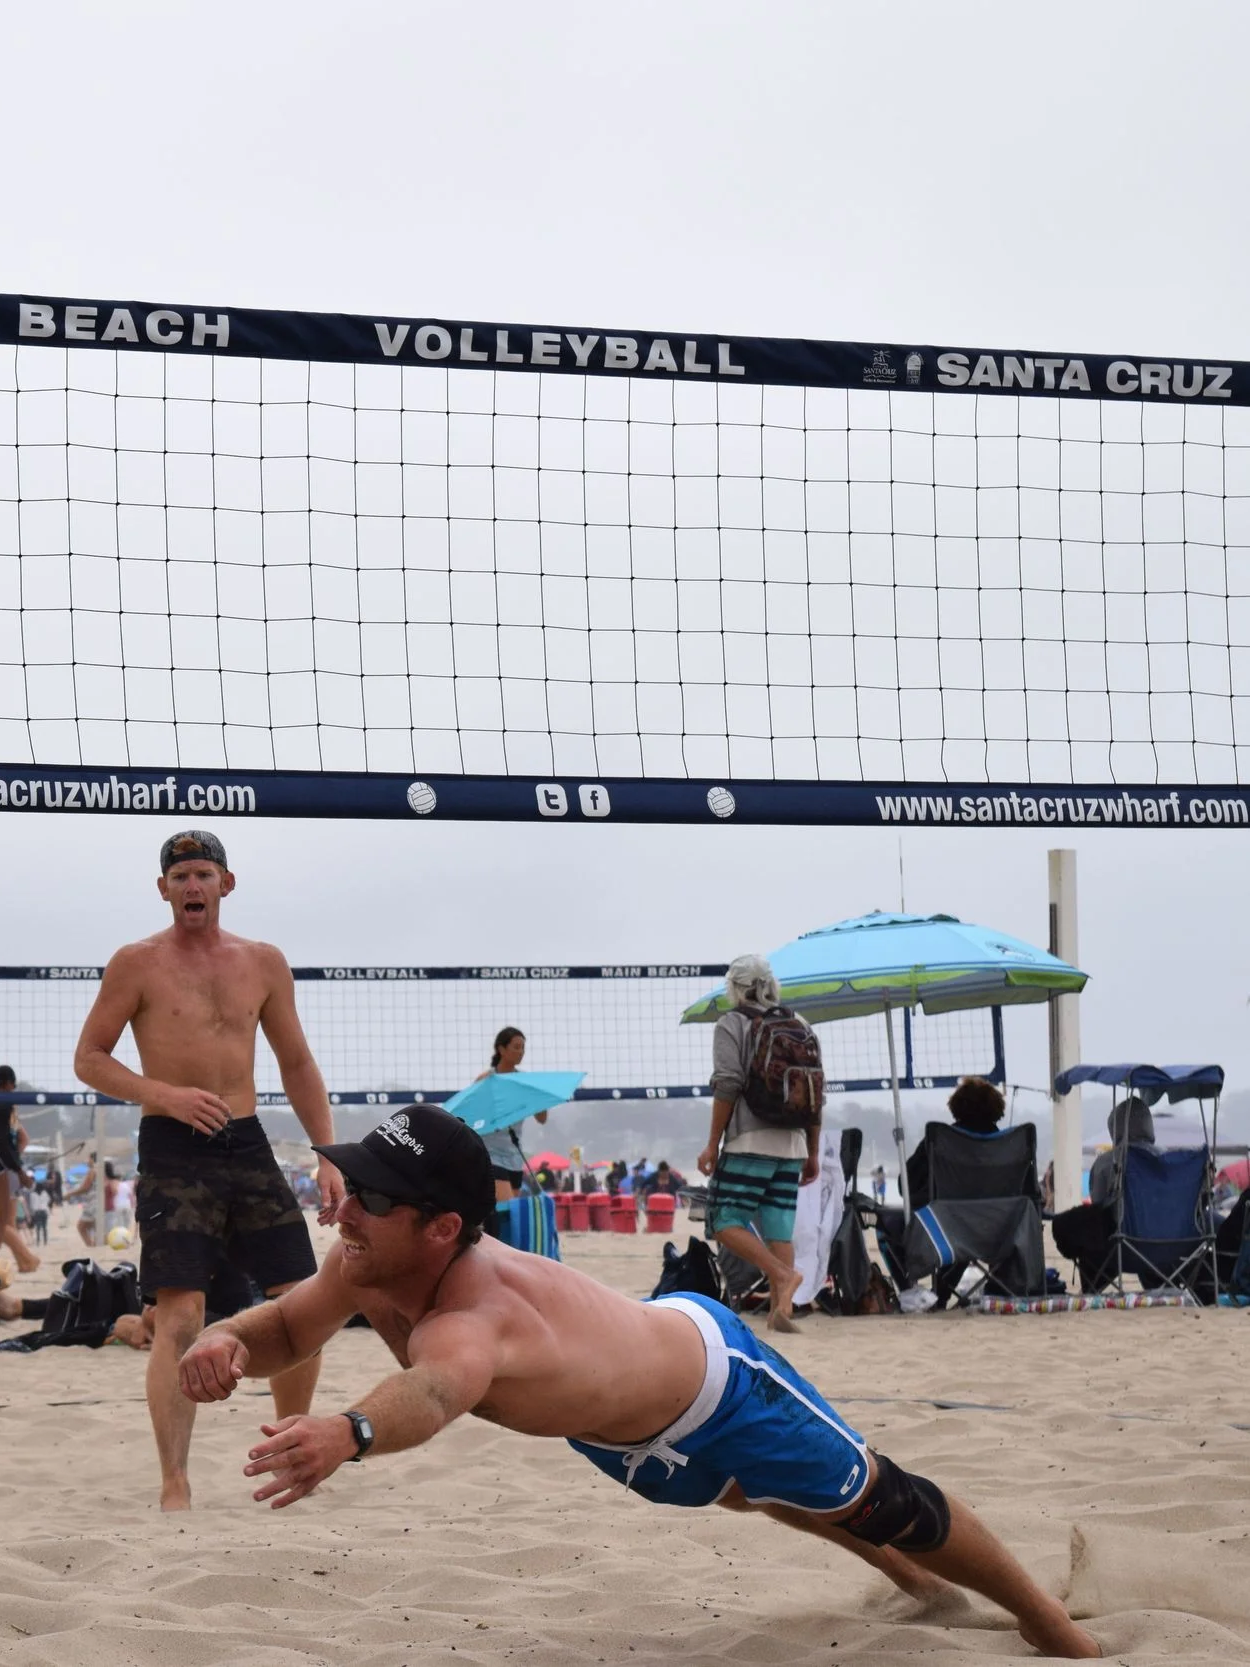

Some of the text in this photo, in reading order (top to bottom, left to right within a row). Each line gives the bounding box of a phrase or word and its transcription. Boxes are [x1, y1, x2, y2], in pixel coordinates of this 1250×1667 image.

[19, 303, 229, 347] BEACH
[374, 323, 745, 375] VOLLEYBALL
[936, 352, 1232, 398] SANTA CRUZ
[875, 791, 1249, 823] www.santacruzwharf.com
[50, 968, 99, 979] SANTA
[323, 968, 428, 979] VOLLEYBALL
[480, 968, 569, 979] SANTA CRUZ
[601, 965, 701, 977] MAIN BEACH
